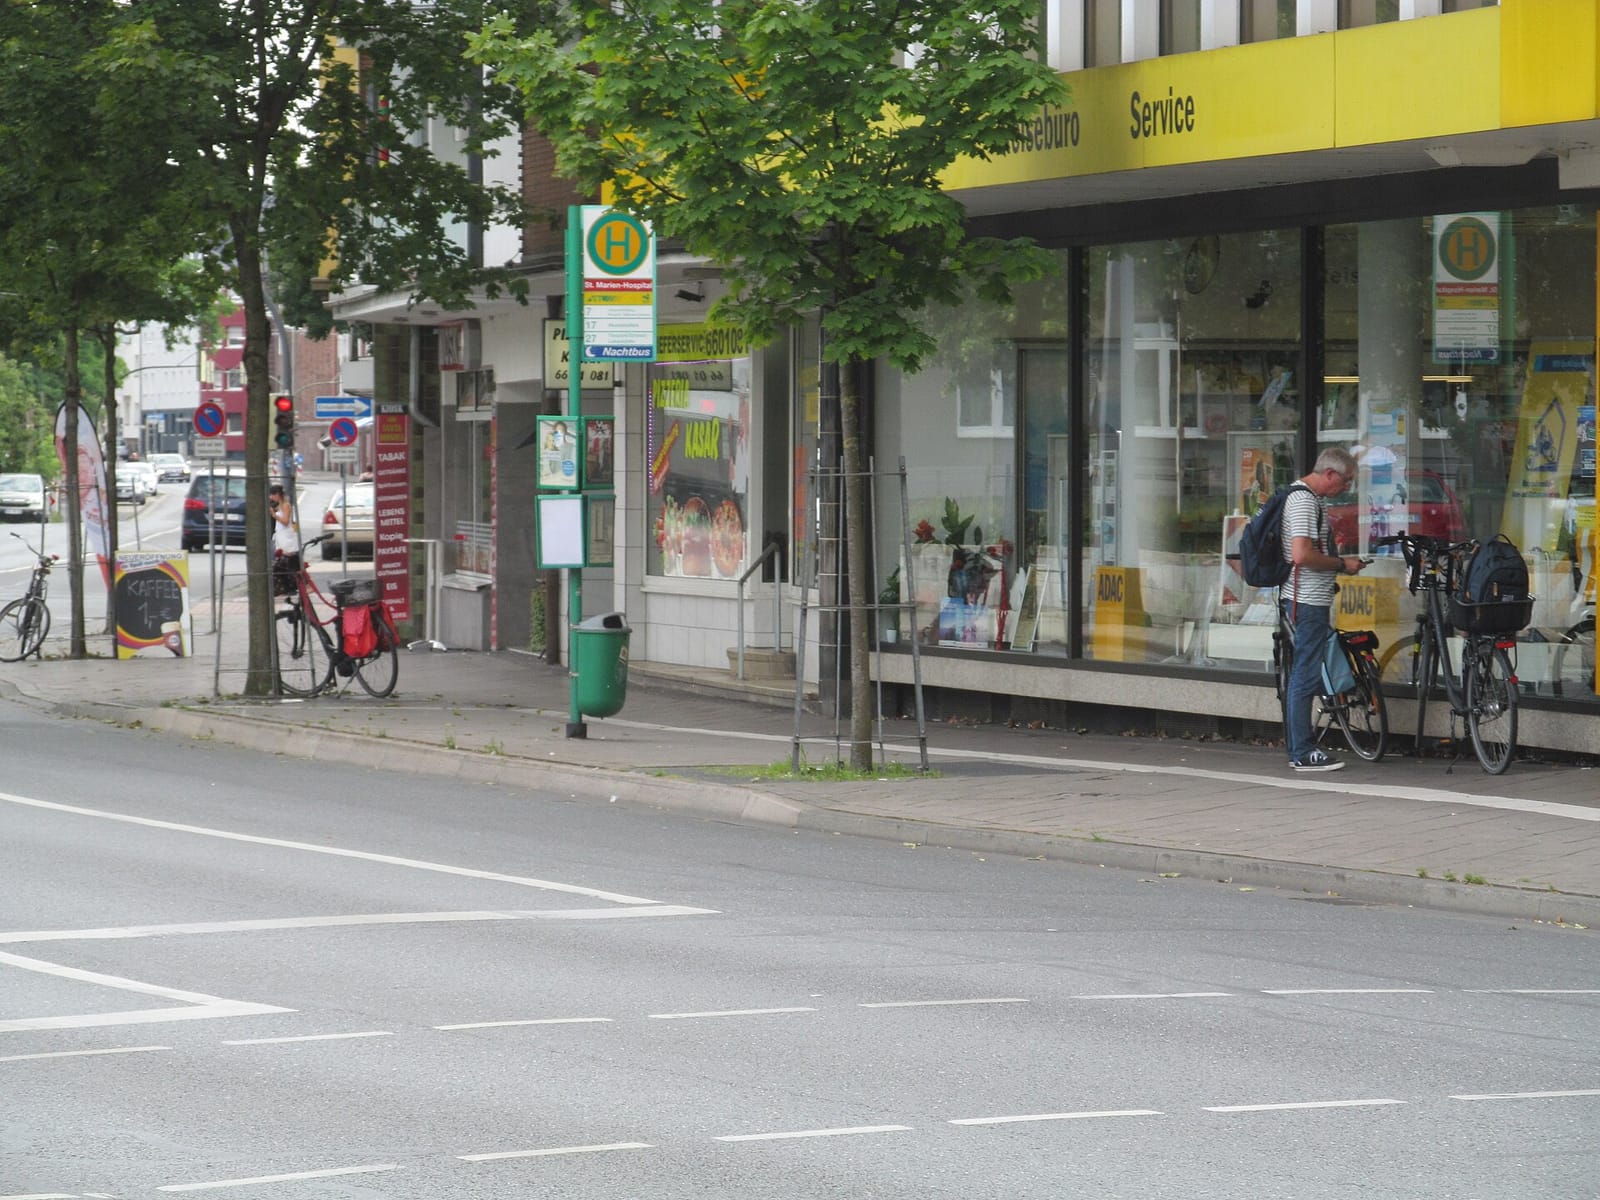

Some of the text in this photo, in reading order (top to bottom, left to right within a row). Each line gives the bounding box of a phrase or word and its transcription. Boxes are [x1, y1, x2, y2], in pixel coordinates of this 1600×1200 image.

[1130, 87, 1195, 139] Service
[605, 226, 631, 261] H
[596, 281, 653, 290] Marien-Hospital
[586, 320, 597, 329] 17
[585, 334, 597, 343] 27
[602, 347, 651, 357] Nachtbus
[554, 369, 568, 380] 66
[590, 370, 609, 381] 081
[377, 452, 406, 461] TABAK
[378, 508, 405, 517] LEBENS
[380, 517, 405, 526] MITTEL
[379, 532, 404, 542] Kopie
[377, 546, 407, 555] PAYSAFE
[127, 579, 180, 600] KAFFEE
[386, 583, 398, 591] EIS
[1098, 574, 1124, 602] ADAC
[1340, 584, 1374, 616] ADAC
